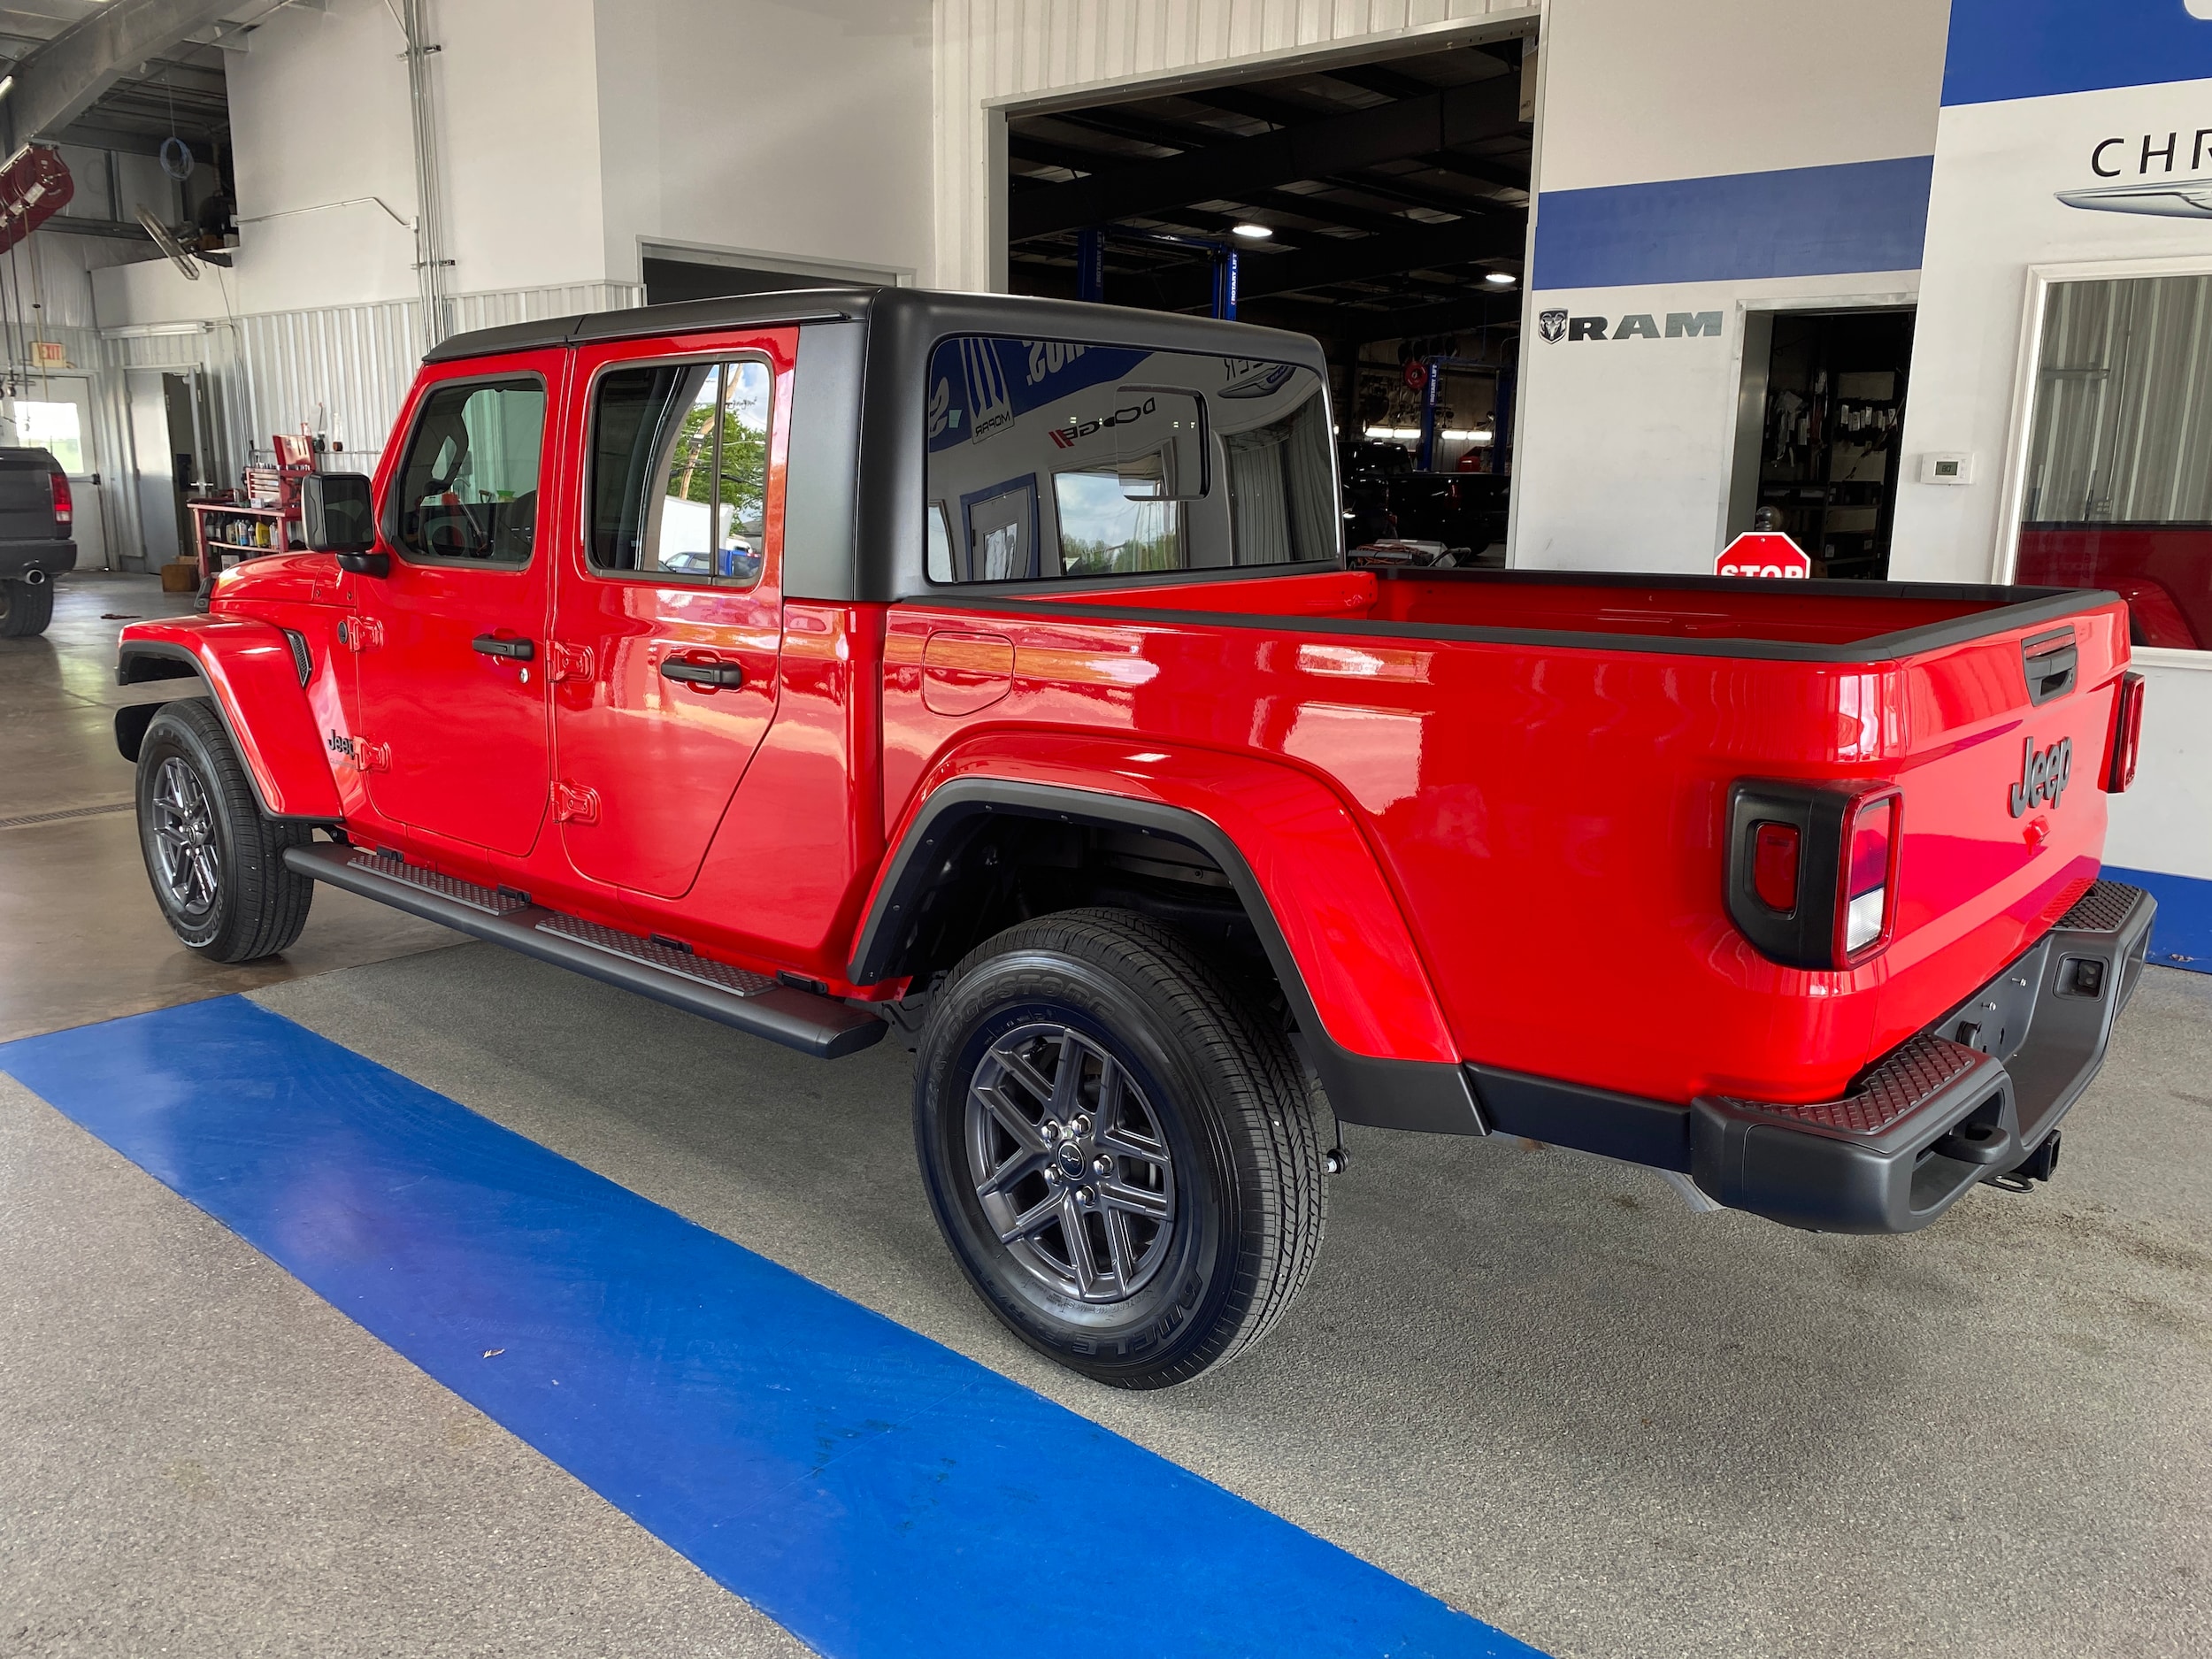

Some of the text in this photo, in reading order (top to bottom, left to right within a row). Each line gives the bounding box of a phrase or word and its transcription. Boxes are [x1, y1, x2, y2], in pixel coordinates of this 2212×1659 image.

[1568, 311, 1724, 342] RAM
[326, 728, 356, 761] Jeep
[2007, 735, 2072, 818] Jeep
